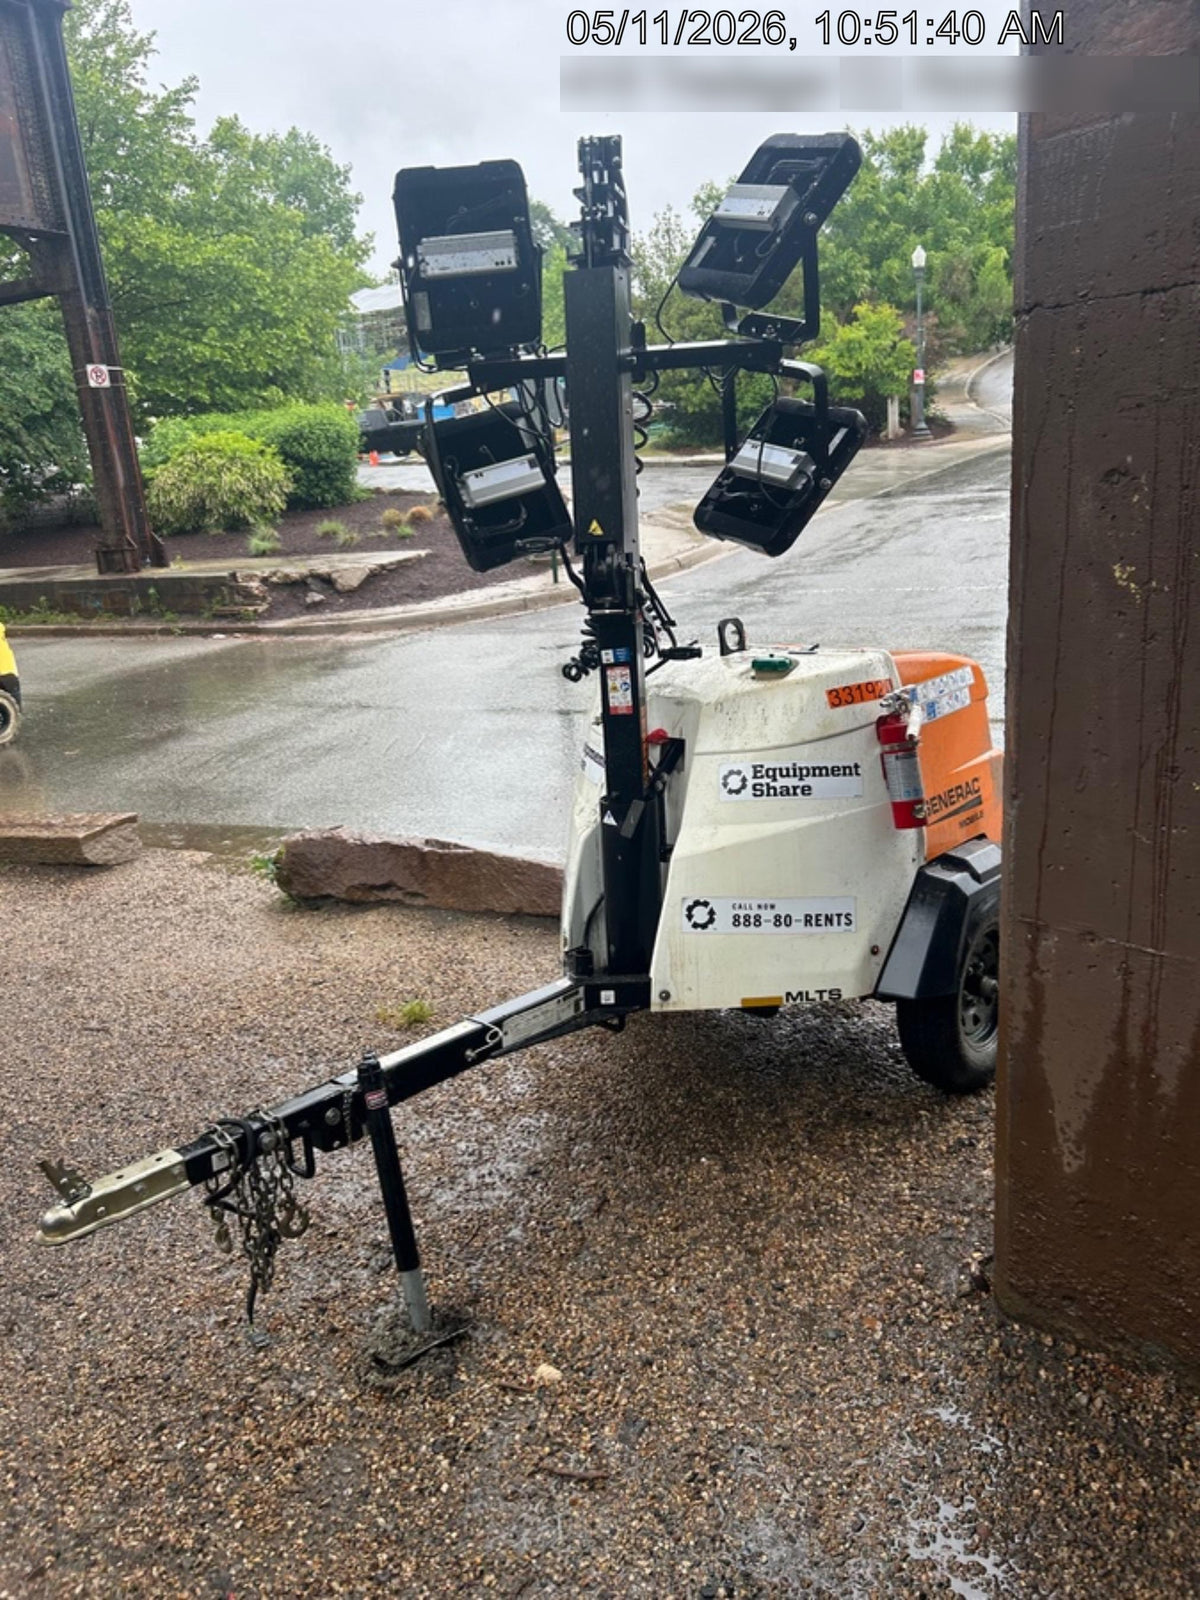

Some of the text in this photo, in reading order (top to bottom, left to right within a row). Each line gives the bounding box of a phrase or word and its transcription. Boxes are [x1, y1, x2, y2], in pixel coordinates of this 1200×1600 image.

[751, 762, 862, 782] Equipment
[751, 782, 812, 798] Share
[732, 903, 776, 911] CALL NOW
[732, 913, 853, 928] 888-80-RENTS
[785, 988, 843, 1003] MLTS
